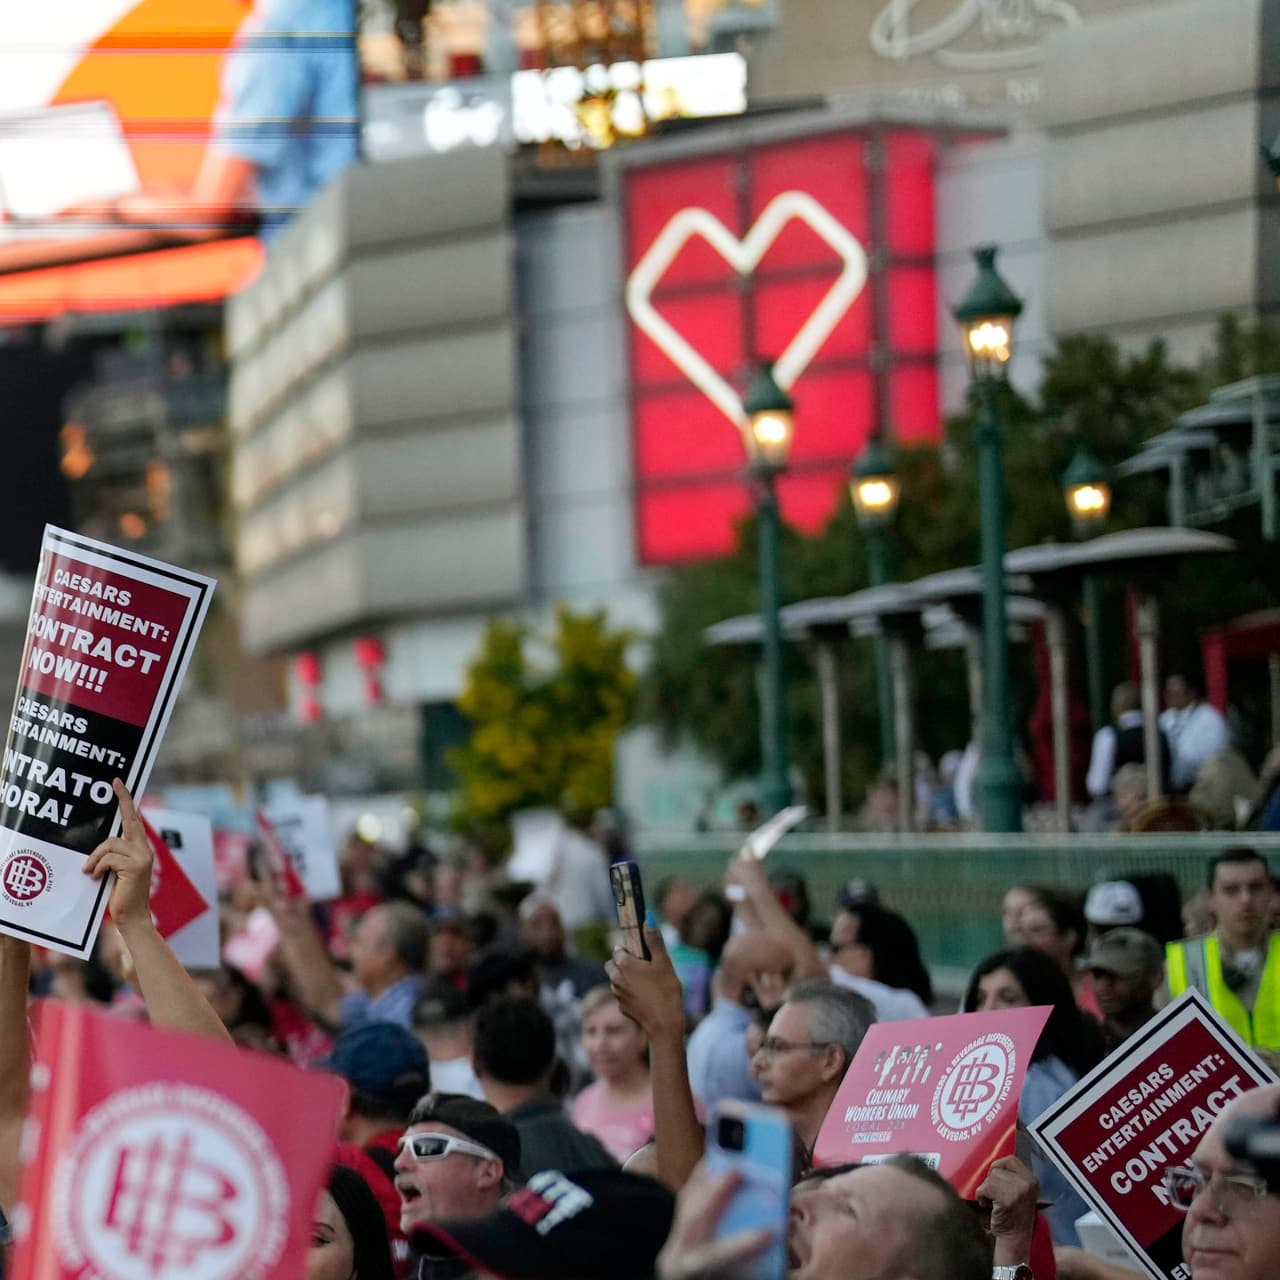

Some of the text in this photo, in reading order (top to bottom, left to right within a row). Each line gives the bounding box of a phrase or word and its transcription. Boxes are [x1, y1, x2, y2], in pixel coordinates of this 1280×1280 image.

[54, 568, 132, 607] CAESARS
[30, 611, 161, 675] CONTRACT
[29, 646, 109, 693] NOW!!!
[18, 696, 89, 734] CAESARS
[12, 714, 126, 769] ERTAINMENT:
[4, 748, 115, 805] NTRATO
[0, 779, 73, 826] HORA!
[844, 1102, 920, 1122] WORKERS UNION
[865, 1087, 911, 1106] CULINARY
[1081, 1053, 1226, 1174] ENTERTAINMENT:
[1098, 1063, 1175, 1130] CAESARS
[1110, 1074, 1244, 1195] CONTRACT
